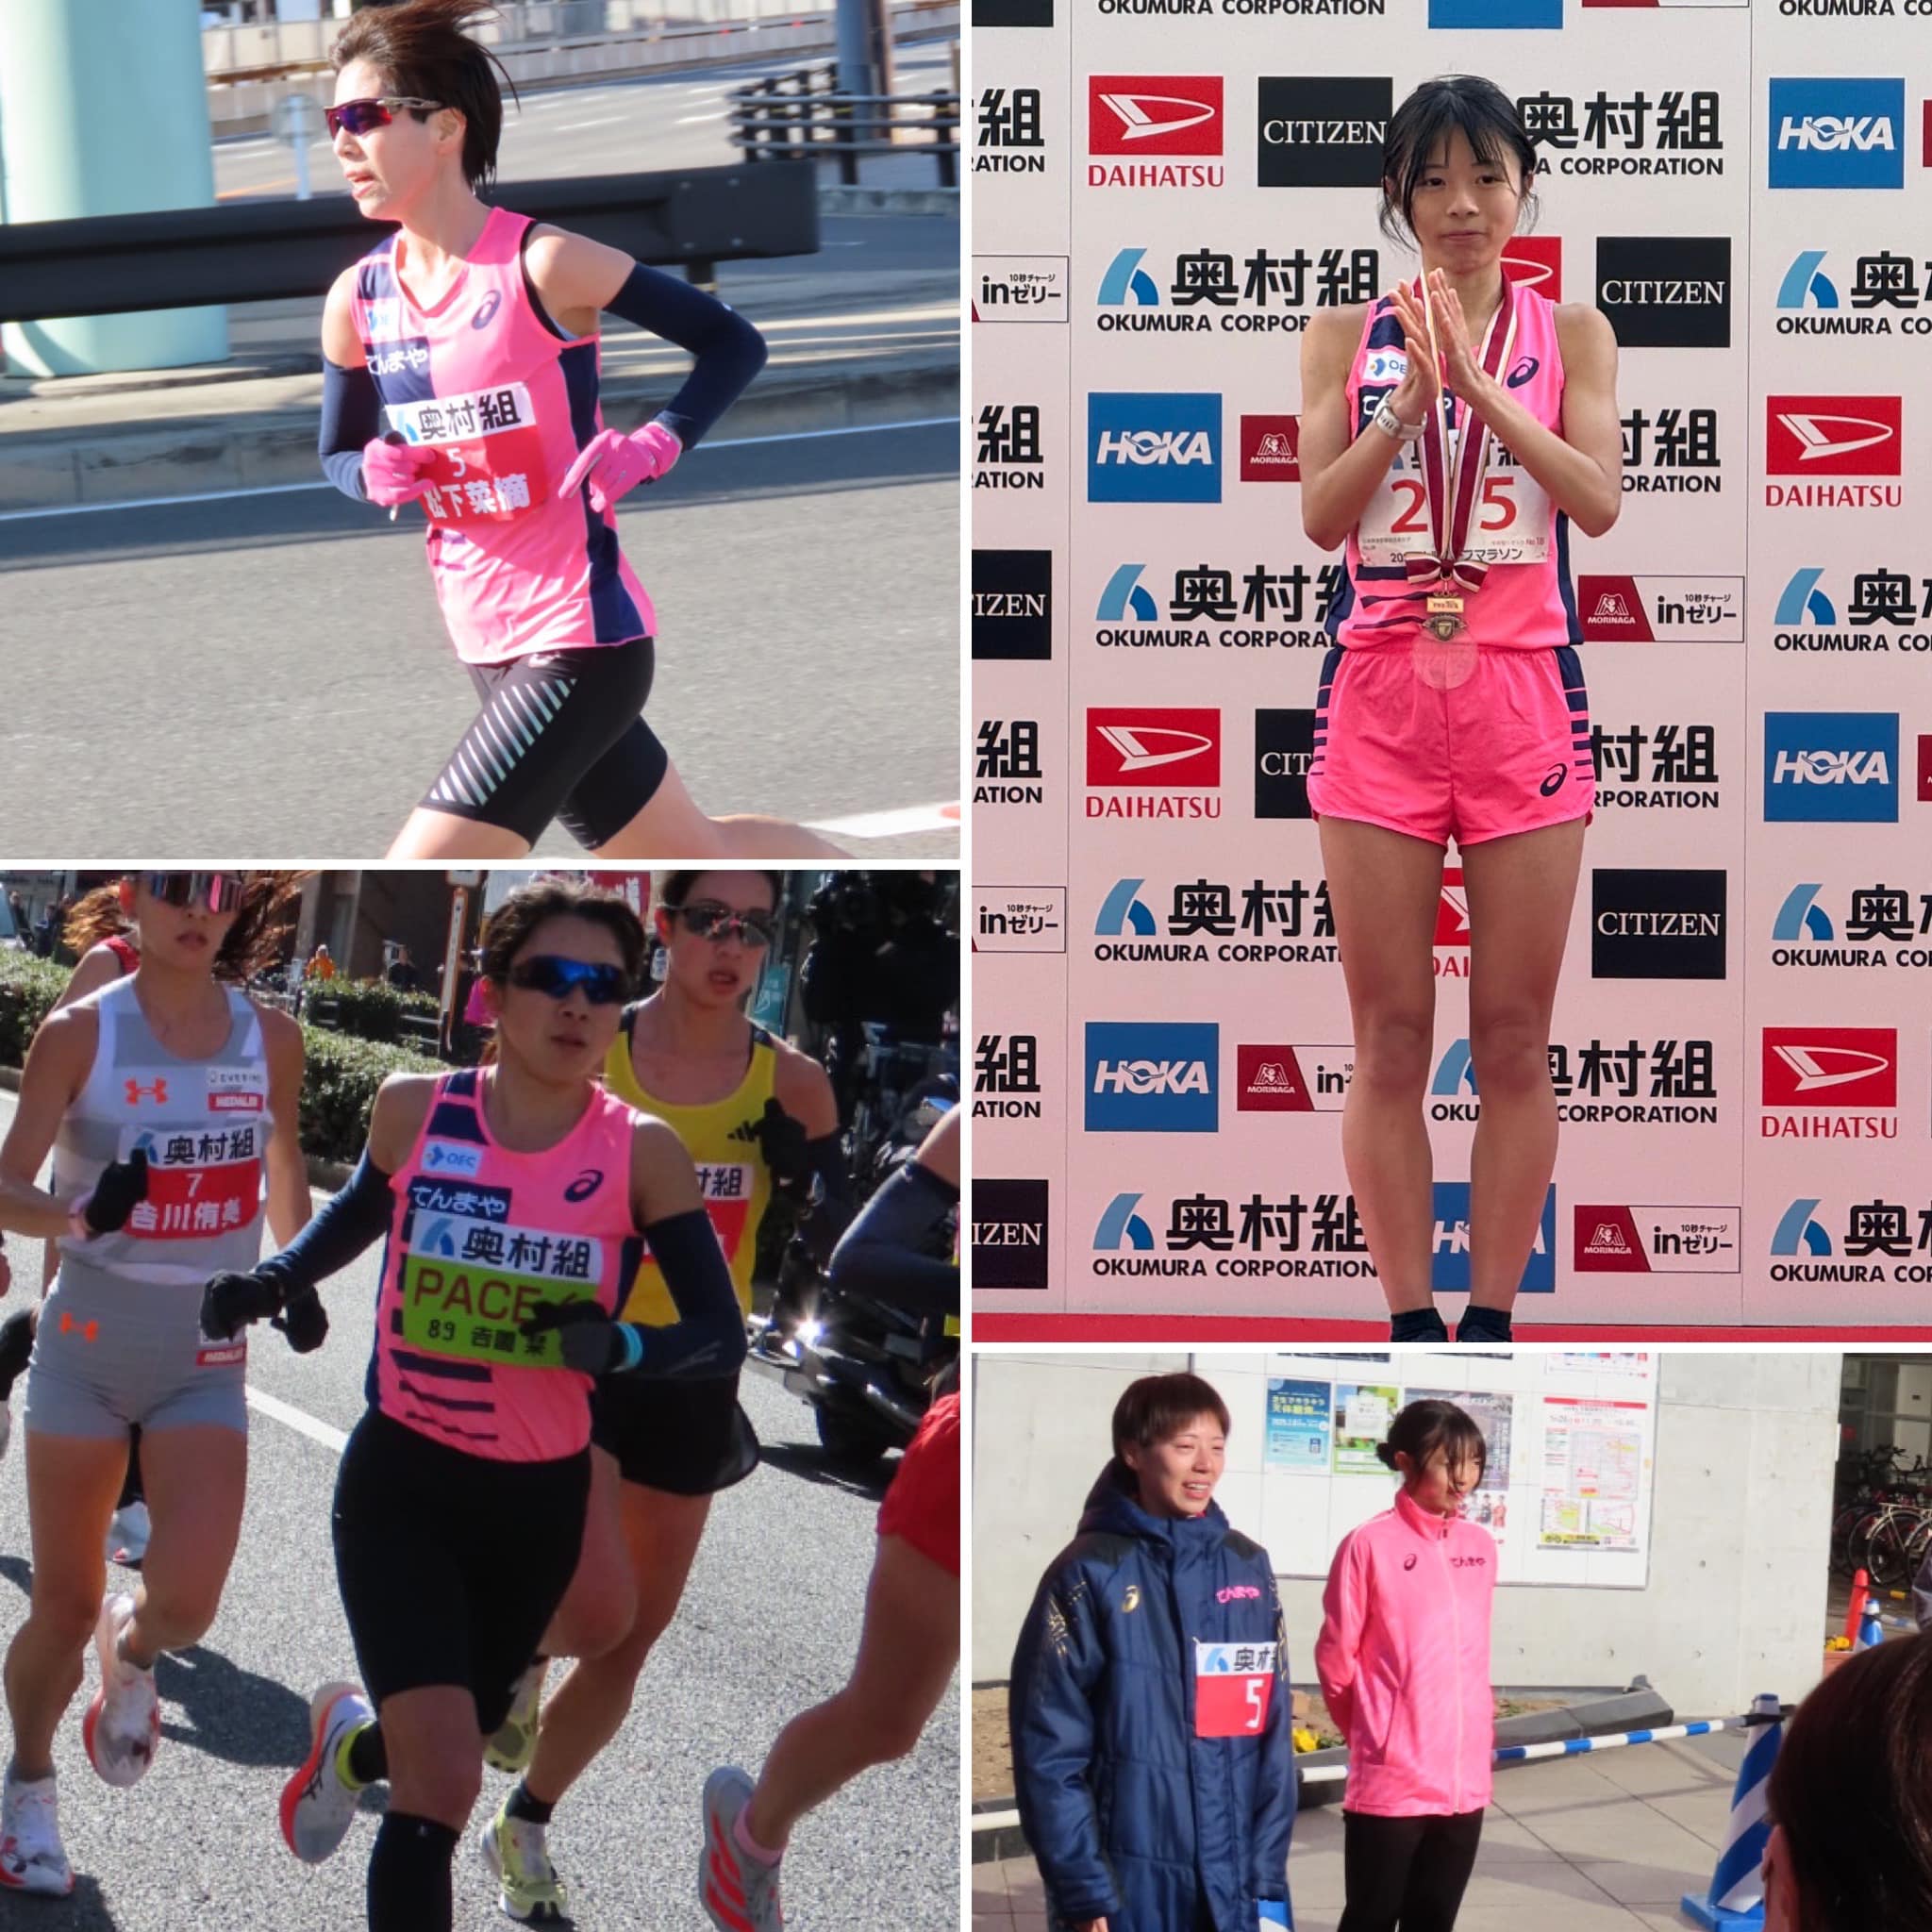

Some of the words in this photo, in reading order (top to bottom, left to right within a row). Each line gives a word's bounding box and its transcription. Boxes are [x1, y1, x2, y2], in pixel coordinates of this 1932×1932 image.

[1099, 0, 1213, 14] OKUMURA
[1225, 0, 1384, 14] CORPORATION
[1779, 0, 1894, 15] OKUMURA
[972, 90, 1044, 146] 組
[1517, 91, 1723, 150] 奥村組
[1264, 121, 1386, 143] CITIZEN
[1778, 117, 1894, 150] HOKA
[972, 156, 1044, 172] ATION
[1561, 158, 1723, 175] CORPORATION
[1089, 166, 1223, 187] DAIHATSU
[982, 275, 1061, 304] inゼリー
[1171, 248, 1379, 307] 奥村組
[1851, 251, 1932, 308] 奥
[1603, 281, 1724, 304] CITIZEN
[1097, 314, 1211, 331] OKUMURA
[1776, 317, 1891, 334] OKUMURA
[418, 390, 521, 441] 奥村組
[972, 406, 1043, 463] 組
[1097, 431, 1211, 464] HOKA
[446, 448, 467, 478] 5
[972, 472, 1043, 489] ATION
[1621, 475, 1721, 492] ORATION
[1766, 485, 1902, 507] DAIHATSU
[972, 593, 1046, 617] IZEN
[1848, 568, 1932, 625] 奥
[1588, 615, 1636, 624] MORINAGA
[1657, 596, 1737, 625] inゼリー
[1096, 630, 1210, 647] OKUMURA
[1774, 634, 1890, 651] OKUMURA
[1898, 634, 1932, 651] CO
[976, 721, 1041, 778] 組
[1591, 725, 1719, 783] 村組
[1260, 752, 1311, 776] CIT
[1774, 751, 1889, 784] HOKA
[974, 787, 1041, 803] ATION
[1086, 795, 1222, 820] DAIHATSU
[979, 906, 1058, 934] inゼリー
[1599, 912, 1720, 935] CITIZEN
[1846, 884, 1932, 941] 奥
[1095, 944, 1208, 961] OKUMURA
[1773, 949, 1887, 966] OKUMURA
[1896, 950, 1932, 967] CO
[974, 1036, 1041, 1092] 組
[1094, 1061, 1208, 1093] HOKA
[1317, 1065, 1351, 1093] in
[972, 1101, 1041, 1118] ATION
[1431, 1103, 1480, 1122] OKU
[1557, 1105, 1717, 1124] CORPORATION
[1761, 1117, 1898, 1139] DAIHATSU
[163, 1127, 255, 1165] 奥村組
[189, 1174, 204, 1197] 7
[412, 1186, 507, 1216] てんまや
[972, 1223, 1043, 1246] IZEN
[1166, 1193, 1369, 1252] 奥村組
[1844, 1199, 1932, 1257] 奥
[461, 1226, 591, 1278] 奥村組
[1584, 1246, 1632, 1255] MORINAGA
[1654, 1225, 1733, 1255] inゼリー
[1093, 1258, 1208, 1276] OKUMURA
[1216, 1259, 1378, 1278] CORPORATION
[1771, 1264, 1885, 1282] OKUMURA
[428, 1319, 455, 1341] 89
[1245, 1678, 1265, 1728] 5
